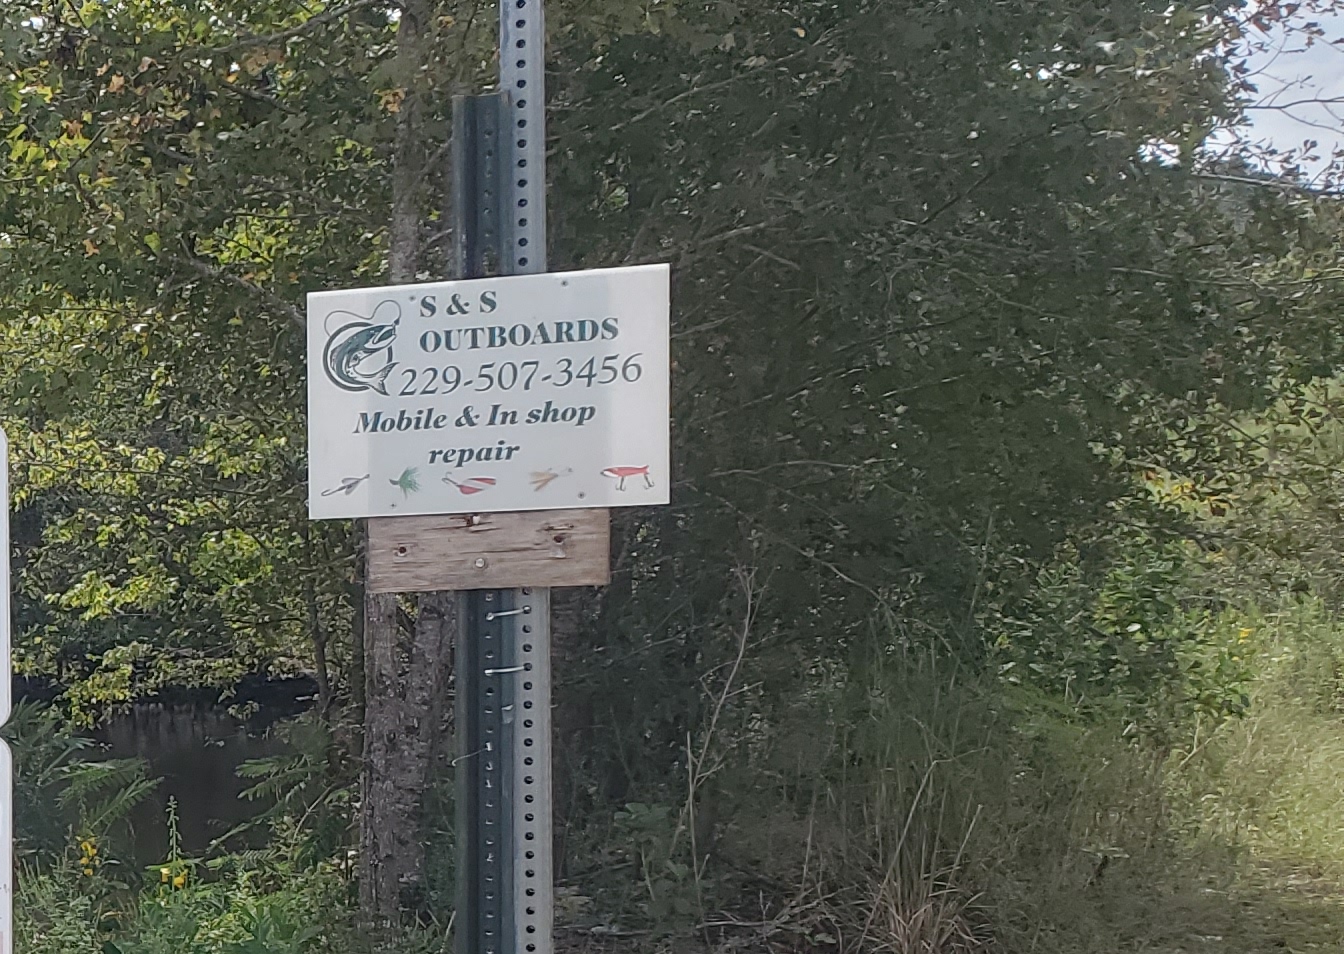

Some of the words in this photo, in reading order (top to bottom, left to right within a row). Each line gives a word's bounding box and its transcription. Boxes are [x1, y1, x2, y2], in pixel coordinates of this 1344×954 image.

[420, 296, 436, 317] S
[446, 294, 471, 316] &
[480, 290, 497, 314] S
[419, 317, 619, 352] OUTBOARDS
[398, 352, 644, 396] 229-507-3456
[352, 408, 447, 433] Mobile
[454, 405, 480, 428] &
[486, 404, 518, 426] In
[525, 400, 596, 426] shop
[428, 440, 520, 467] repair
